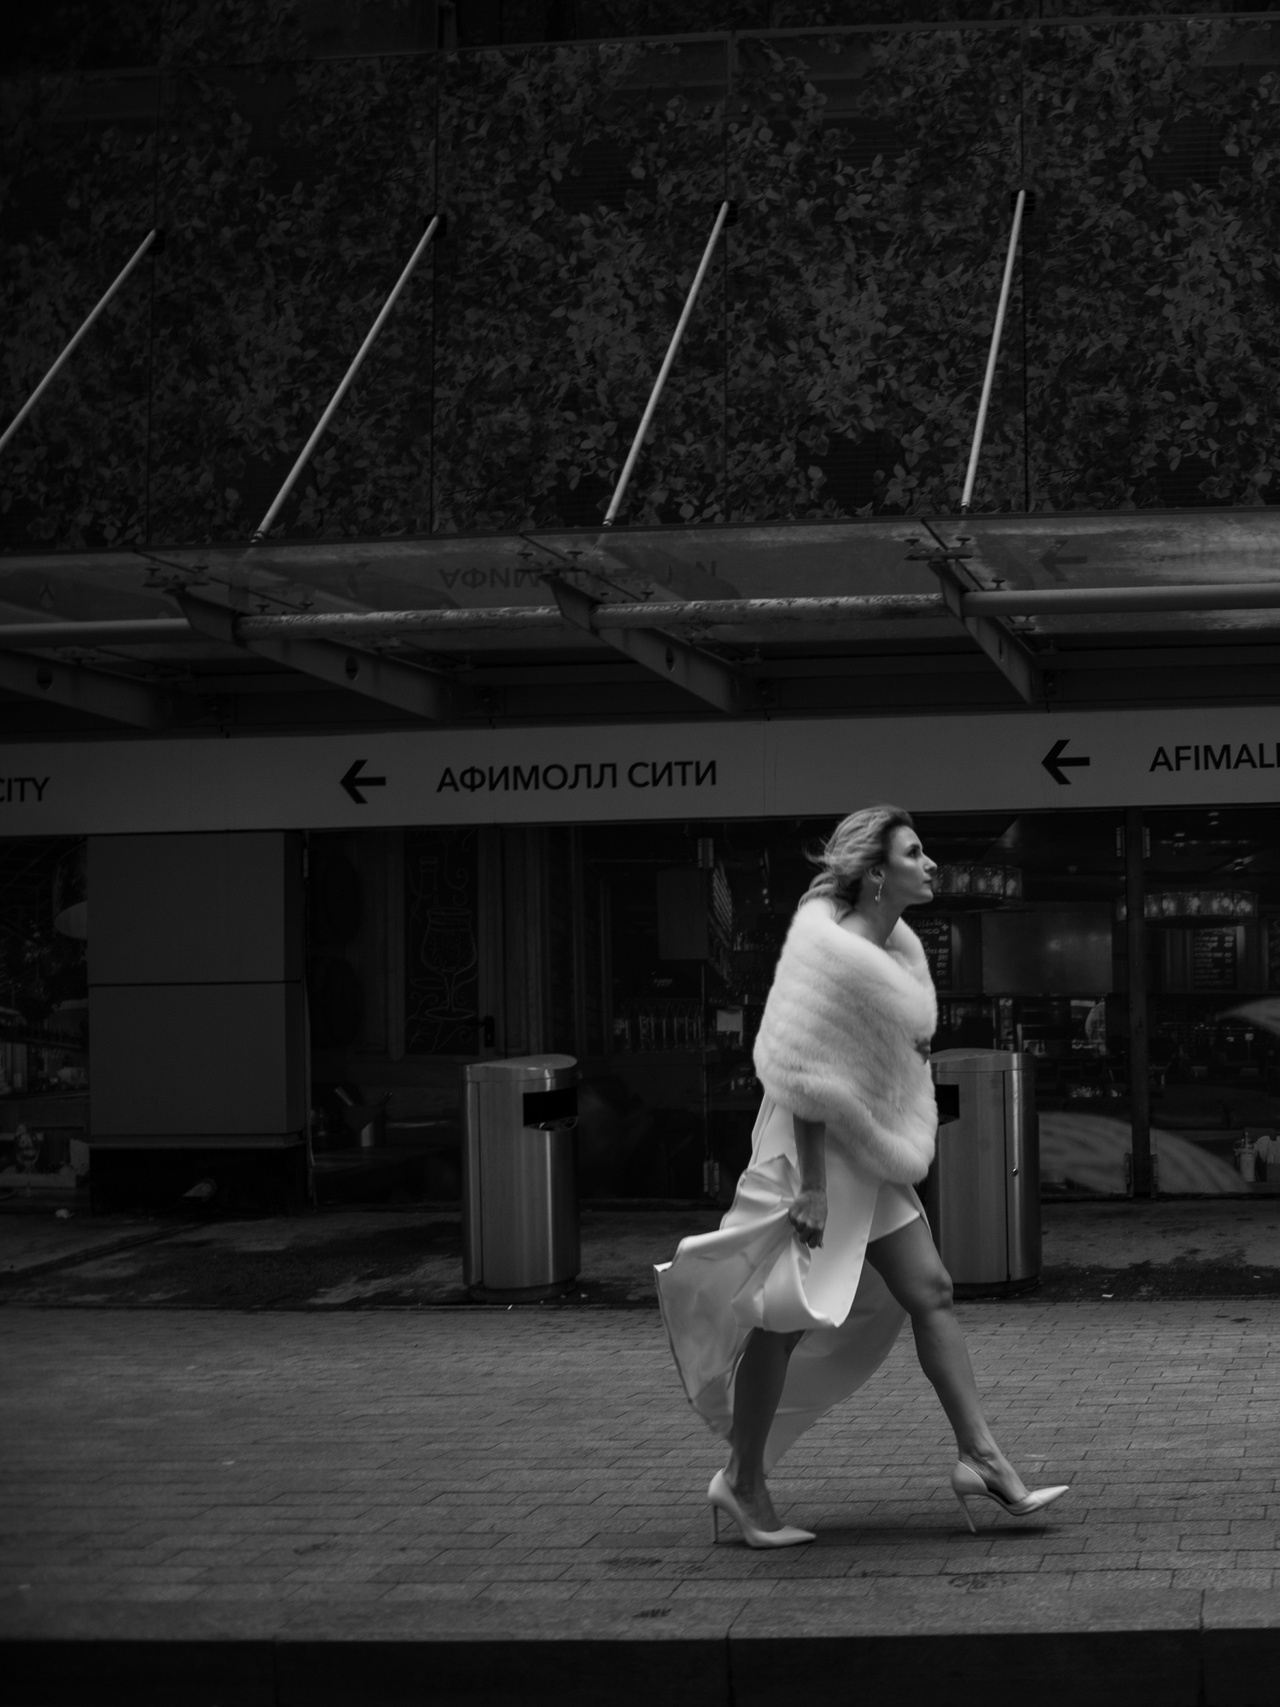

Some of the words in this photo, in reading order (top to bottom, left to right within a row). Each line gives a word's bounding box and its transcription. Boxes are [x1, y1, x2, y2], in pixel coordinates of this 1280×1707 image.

[0, 776, 50, 803] ITY
[436, 763, 617, 793] АФИМОЛЛ
[627, 760, 717, 788] СИТИ
